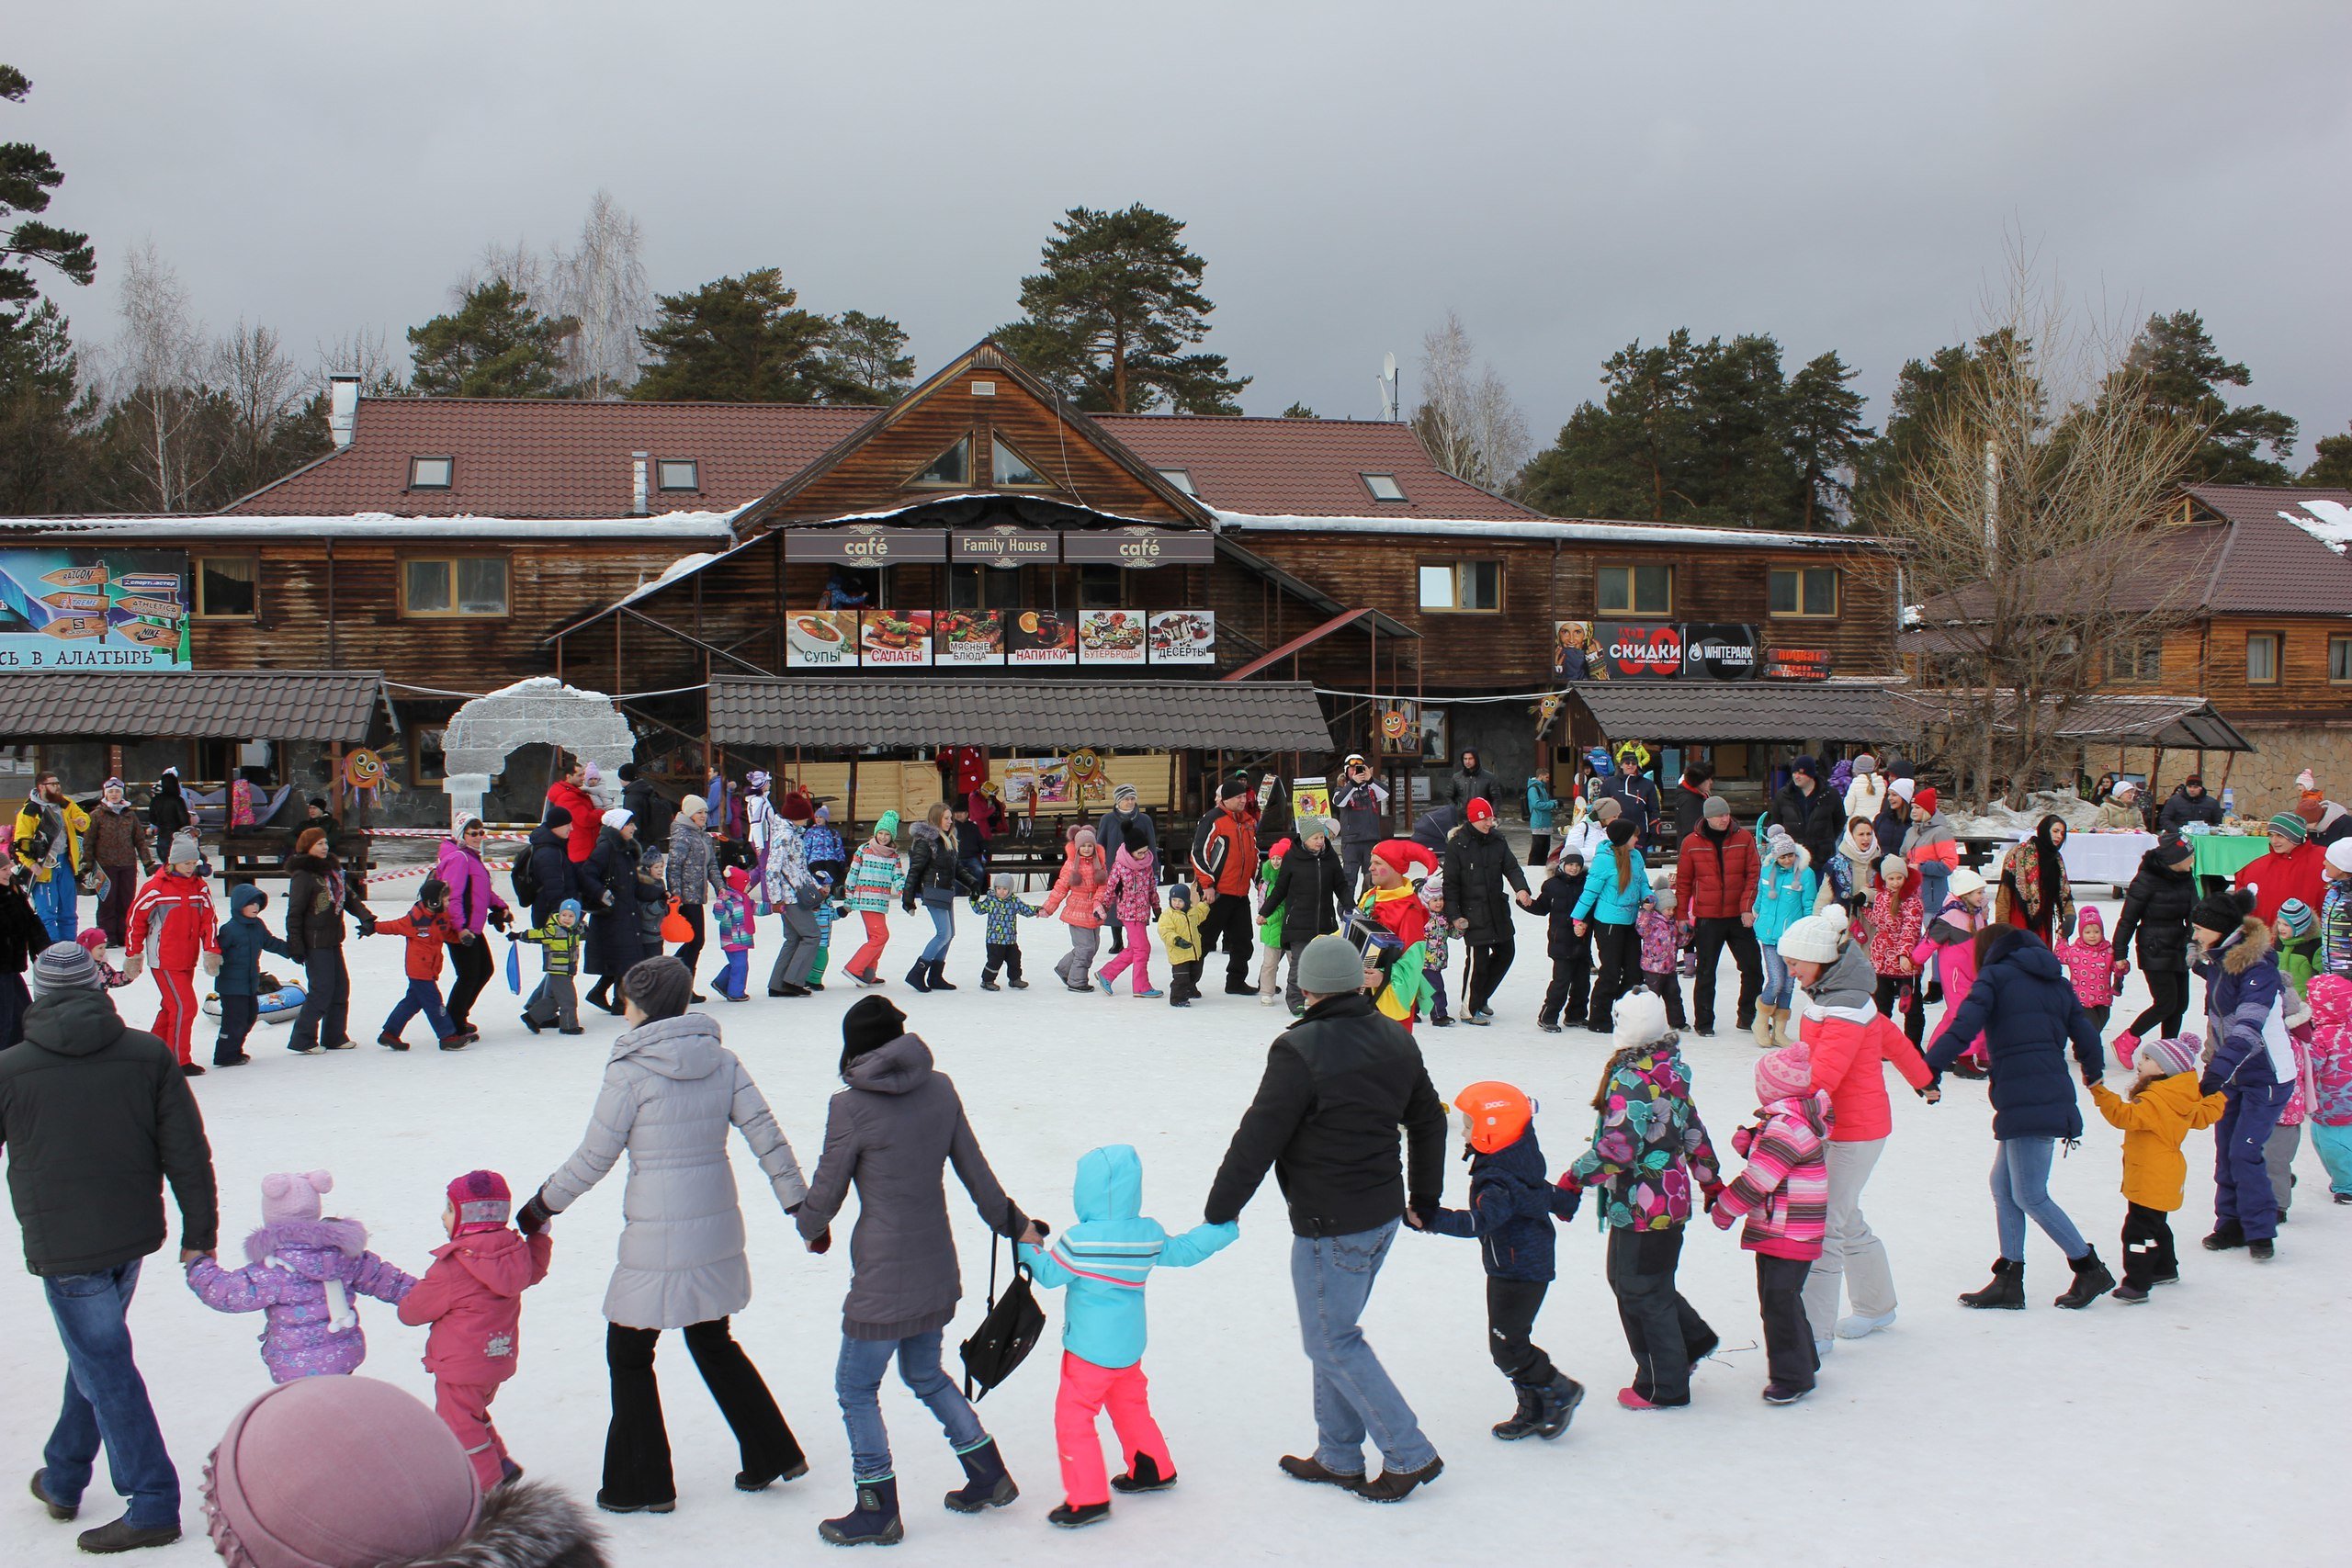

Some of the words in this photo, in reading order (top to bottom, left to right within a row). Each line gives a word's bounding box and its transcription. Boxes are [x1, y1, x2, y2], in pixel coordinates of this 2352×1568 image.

[844, 537, 888, 555] café
[963, 538, 1004, 554] Family
[1009, 538, 1047, 552] House
[1119, 540, 1160, 557] café
[133, 600, 176, 612] ATHLETICA
[142, 627, 160, 637] NIKE
[950, 642, 990, 651] МЯСНЫЕ
[1609, 644, 1681, 660] СКИДКИ
[1704, 646, 1753, 659] WHITEPARK
[804, 650, 841, 662] СУПЫ
[871, 649, 922, 661] САЛАТЫ
[954, 652, 987, 660] БЛЮДА
[1016, 649, 1068, 660] НАПИТКИ
[1084, 649, 1141, 660] БУТЕРБРОДЫ
[1159, 648, 1207, 659] ДЕСЕРТЫ
